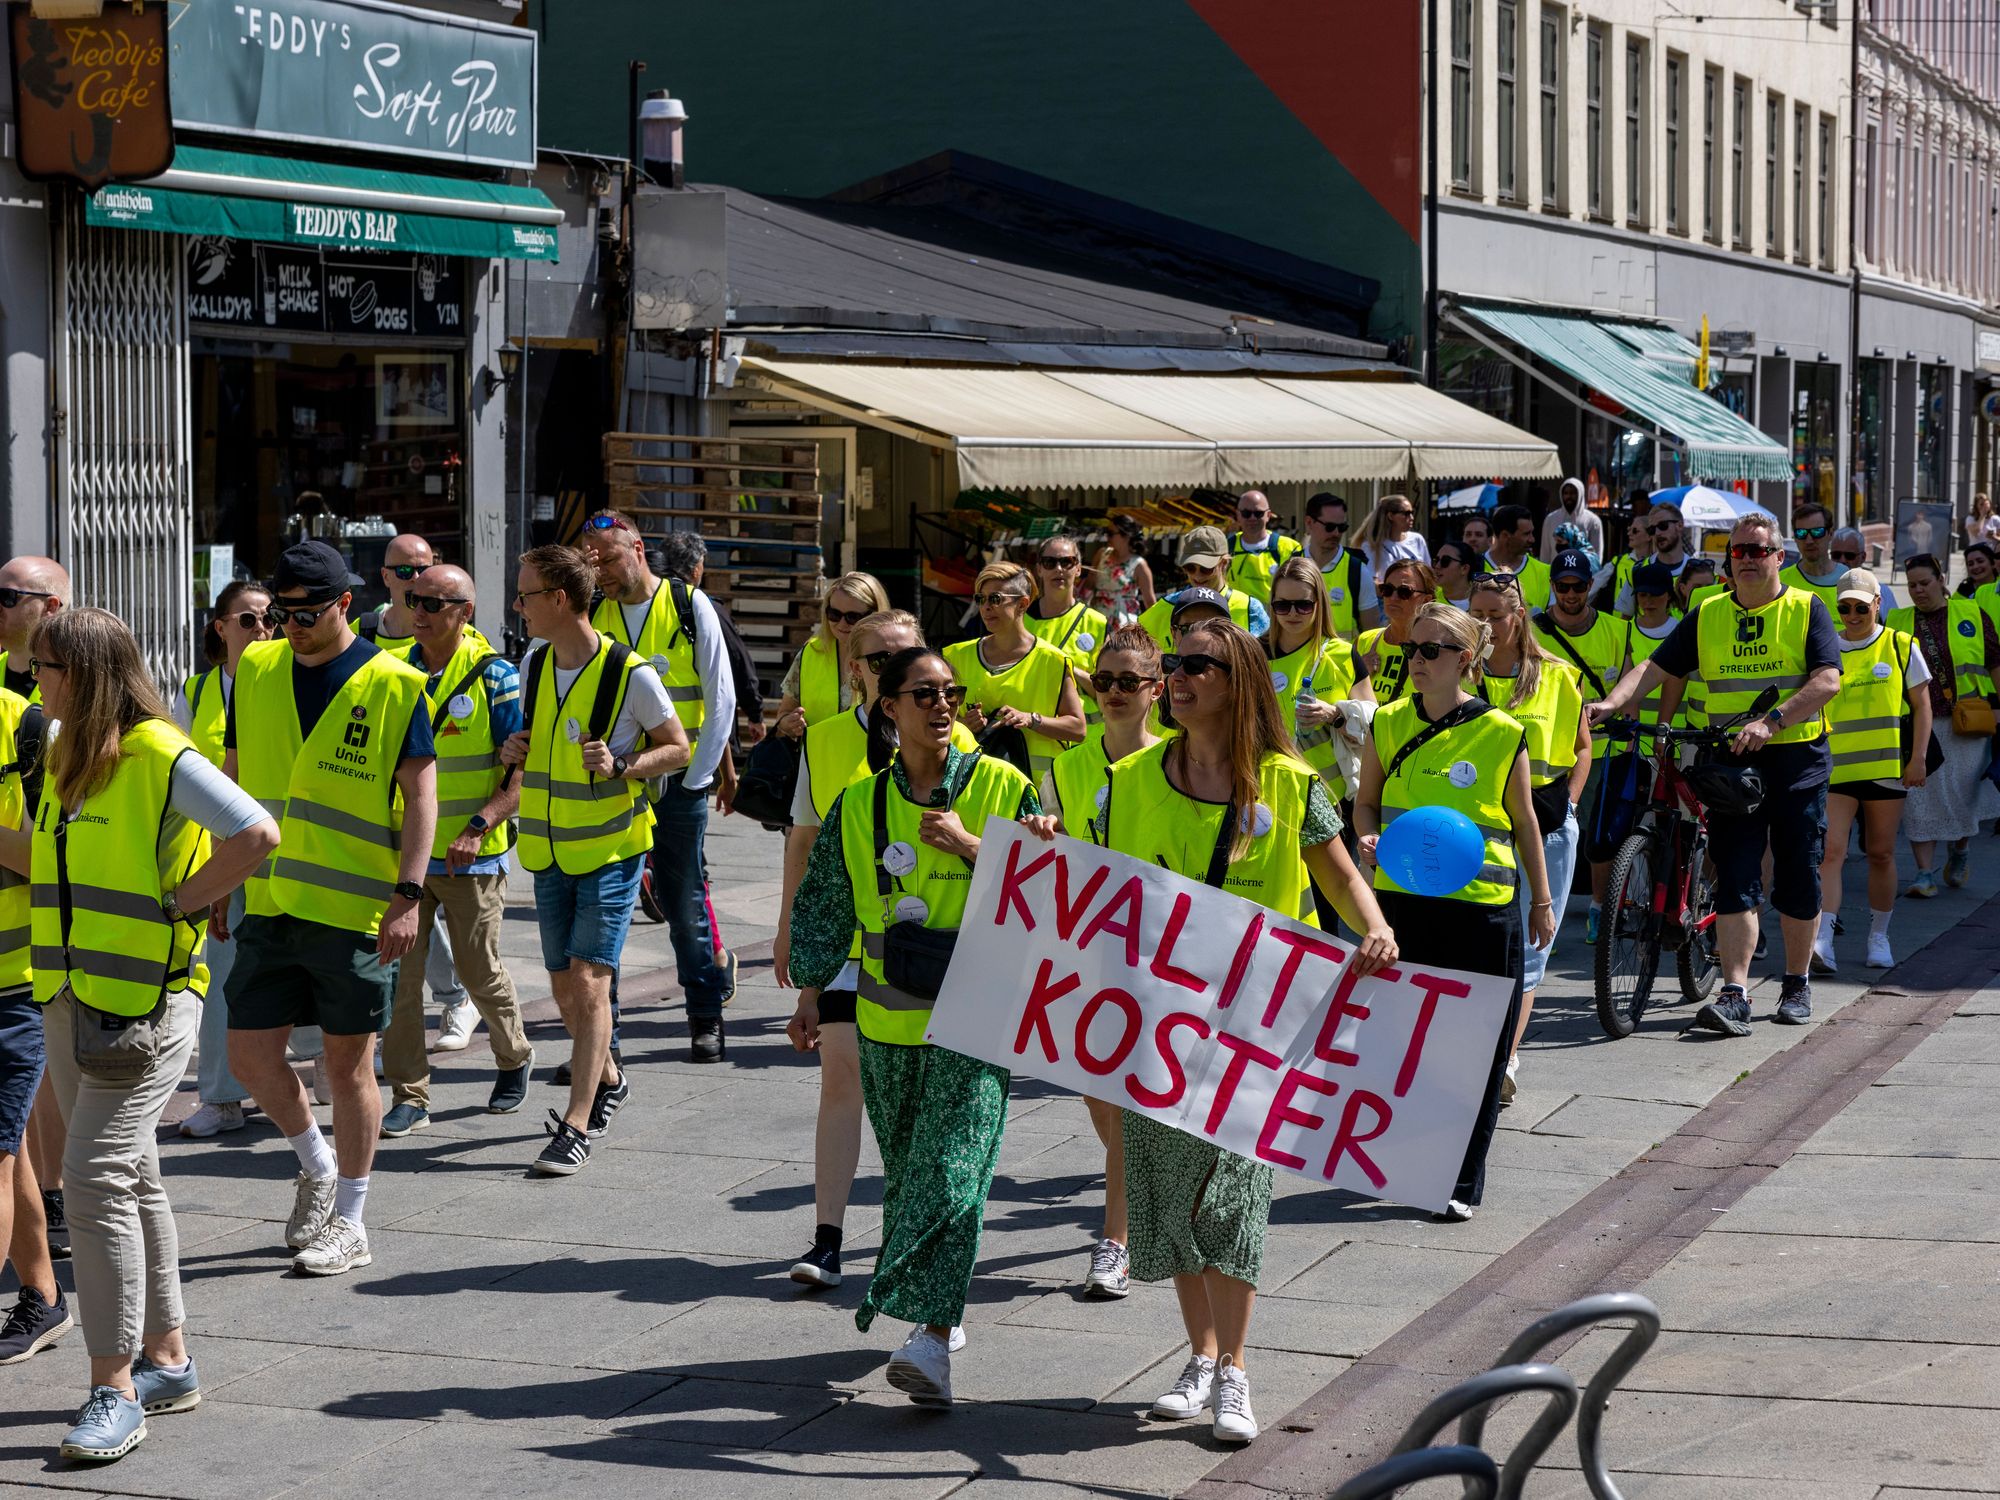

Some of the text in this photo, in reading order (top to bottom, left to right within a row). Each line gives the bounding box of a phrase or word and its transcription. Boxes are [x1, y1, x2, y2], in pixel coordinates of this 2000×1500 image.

[65, 26, 163, 77] Teddy's
[77, 69, 156, 117] Café
[353, 42, 517, 148] Soft Bar
[293, 203, 398, 242] TEDDY'S BAR
[278, 264, 312, 288] MILK
[328, 275, 355, 298] HOT
[187, 293, 252, 320] KALLDYR
[278, 288, 319, 313] SHAKE
[374, 306, 408, 330] DOGS
[436, 303, 459, 325] VIN
[1732, 642, 1768, 657] Unio
[1719, 660, 1784, 674] STREIKEVAKT
[335, 747, 367, 765] Unio
[317, 761, 377, 782] STREIKEVAKT
[928, 871, 974, 881] akademik
[1195, 871, 1264, 888] akmikerne
[994, 839, 1471, 1098] KVALITET
[1013, 958, 1393, 1190] KOSTER
